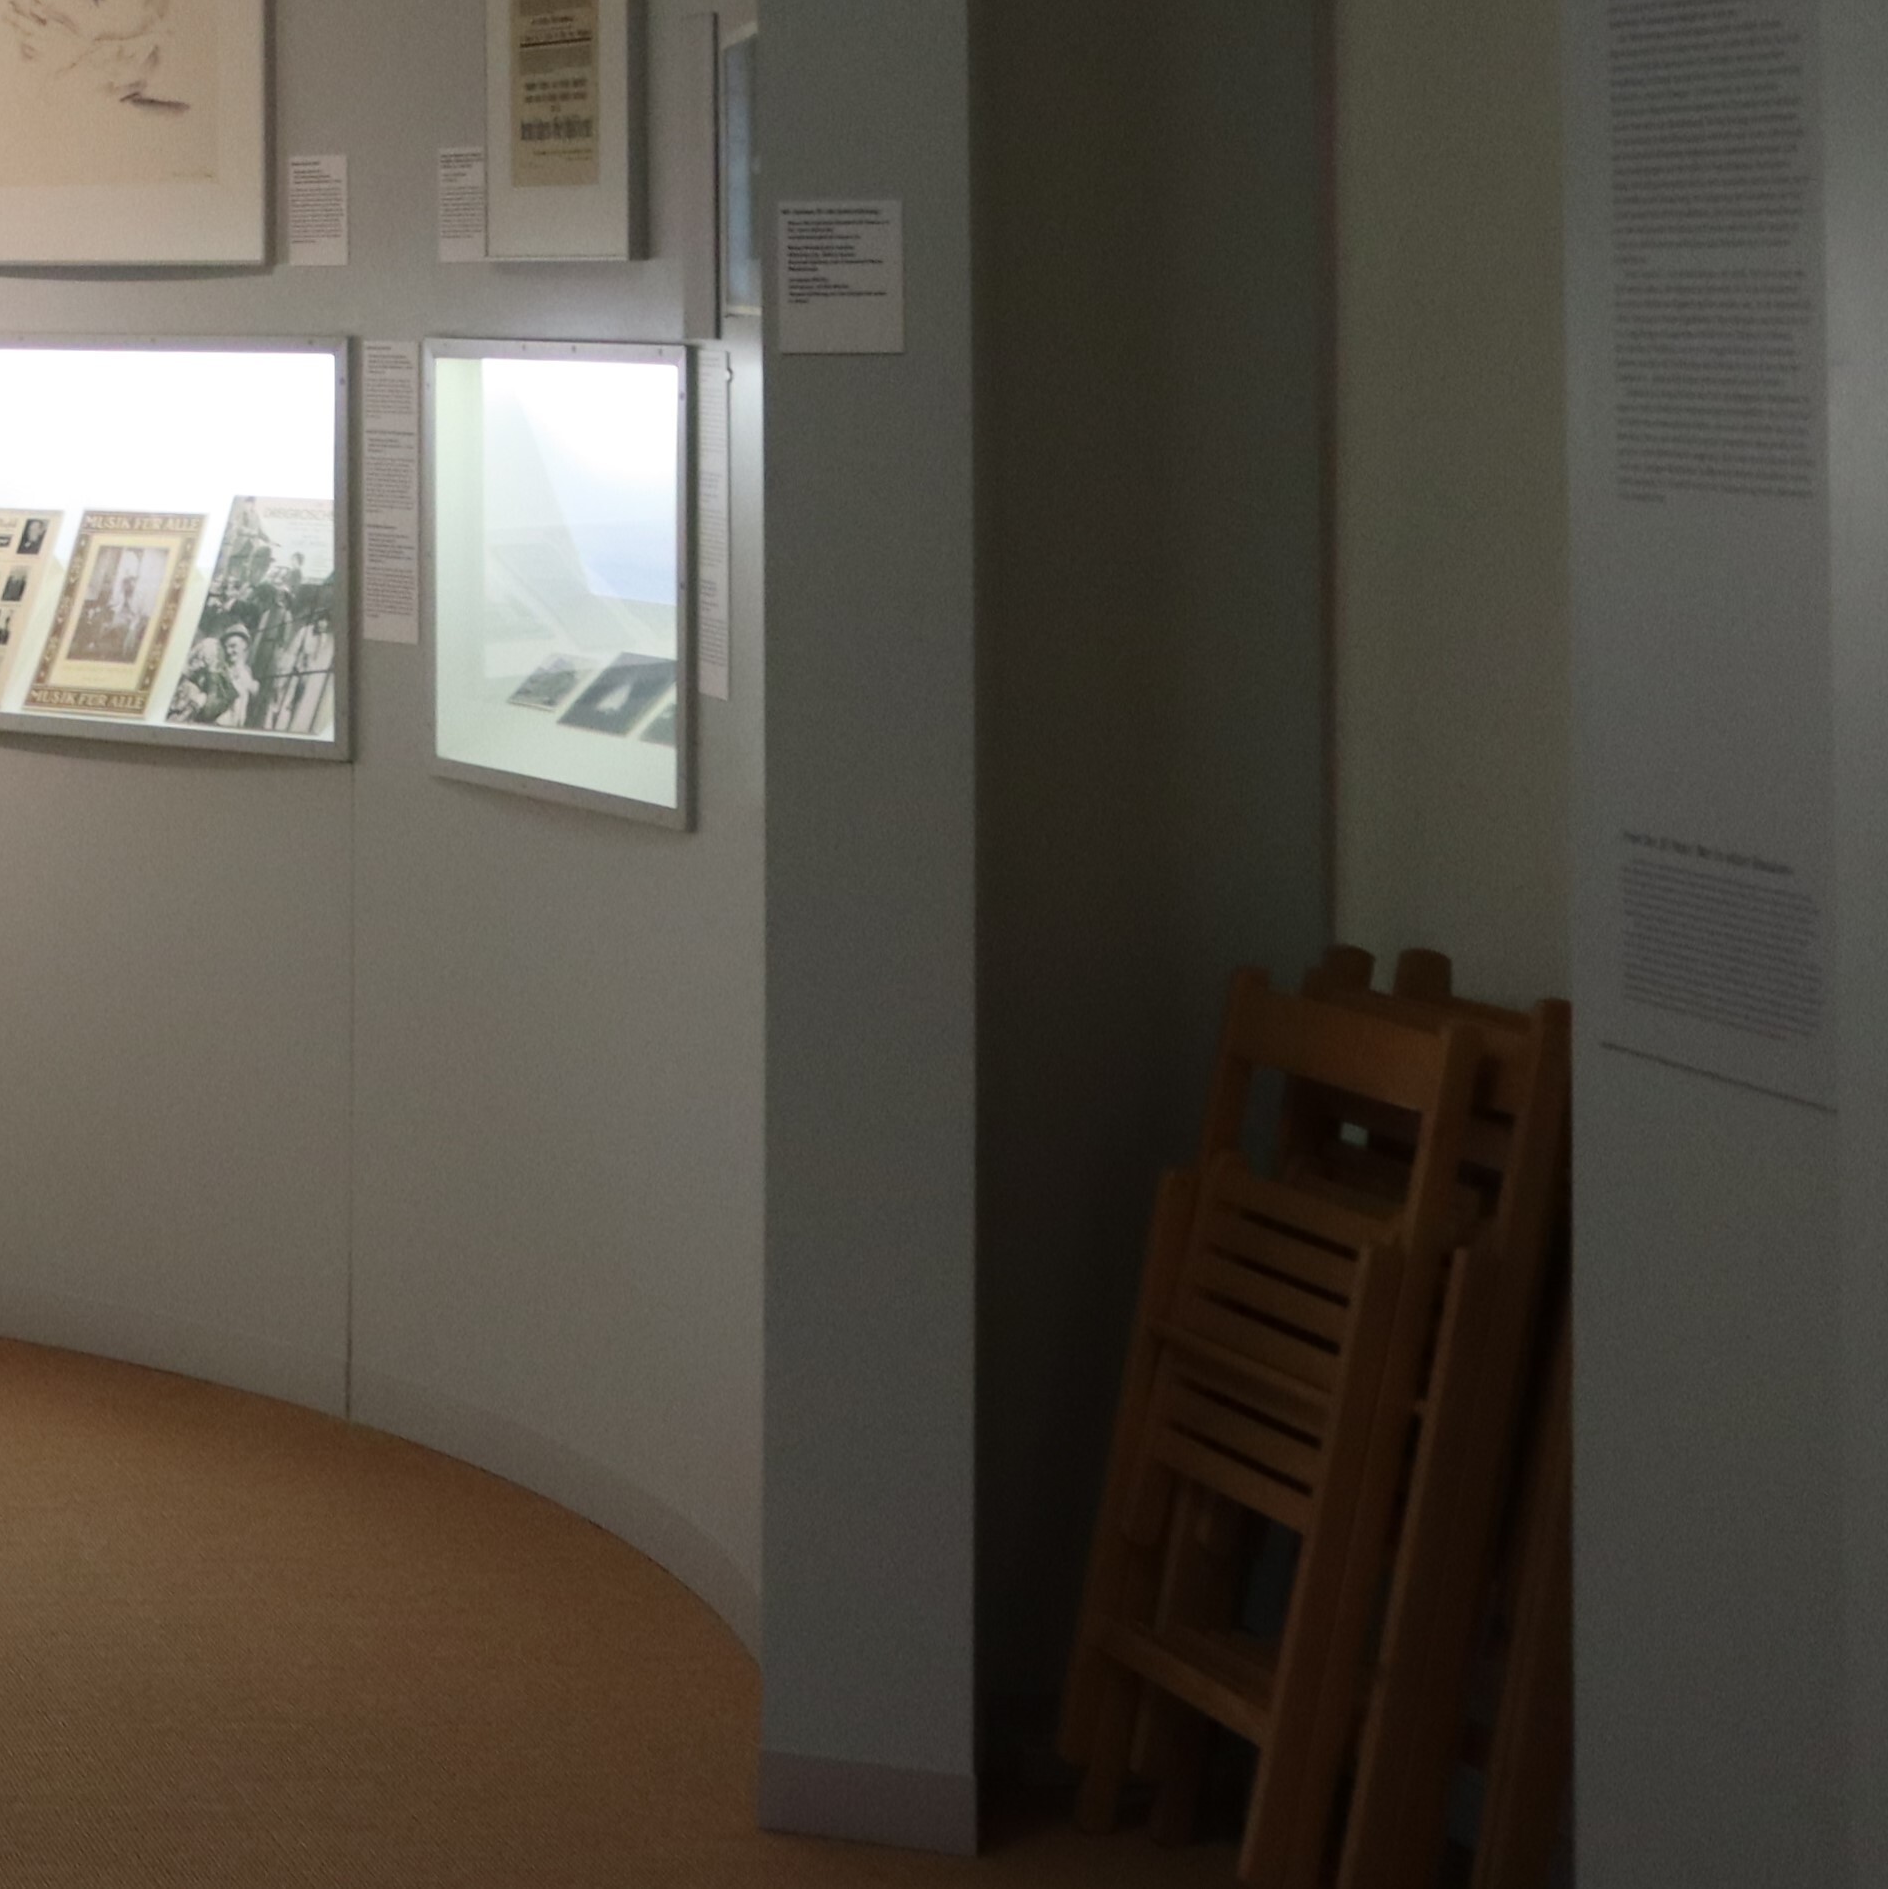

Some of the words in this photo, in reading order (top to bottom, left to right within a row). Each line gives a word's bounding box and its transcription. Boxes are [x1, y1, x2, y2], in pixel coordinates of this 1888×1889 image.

[83, 514, 131, 530] MUSIK
[164, 517, 202, 531] ALLE
[29, 690, 76, 705] MUSIK
[108, 695, 145, 709] ALLE
